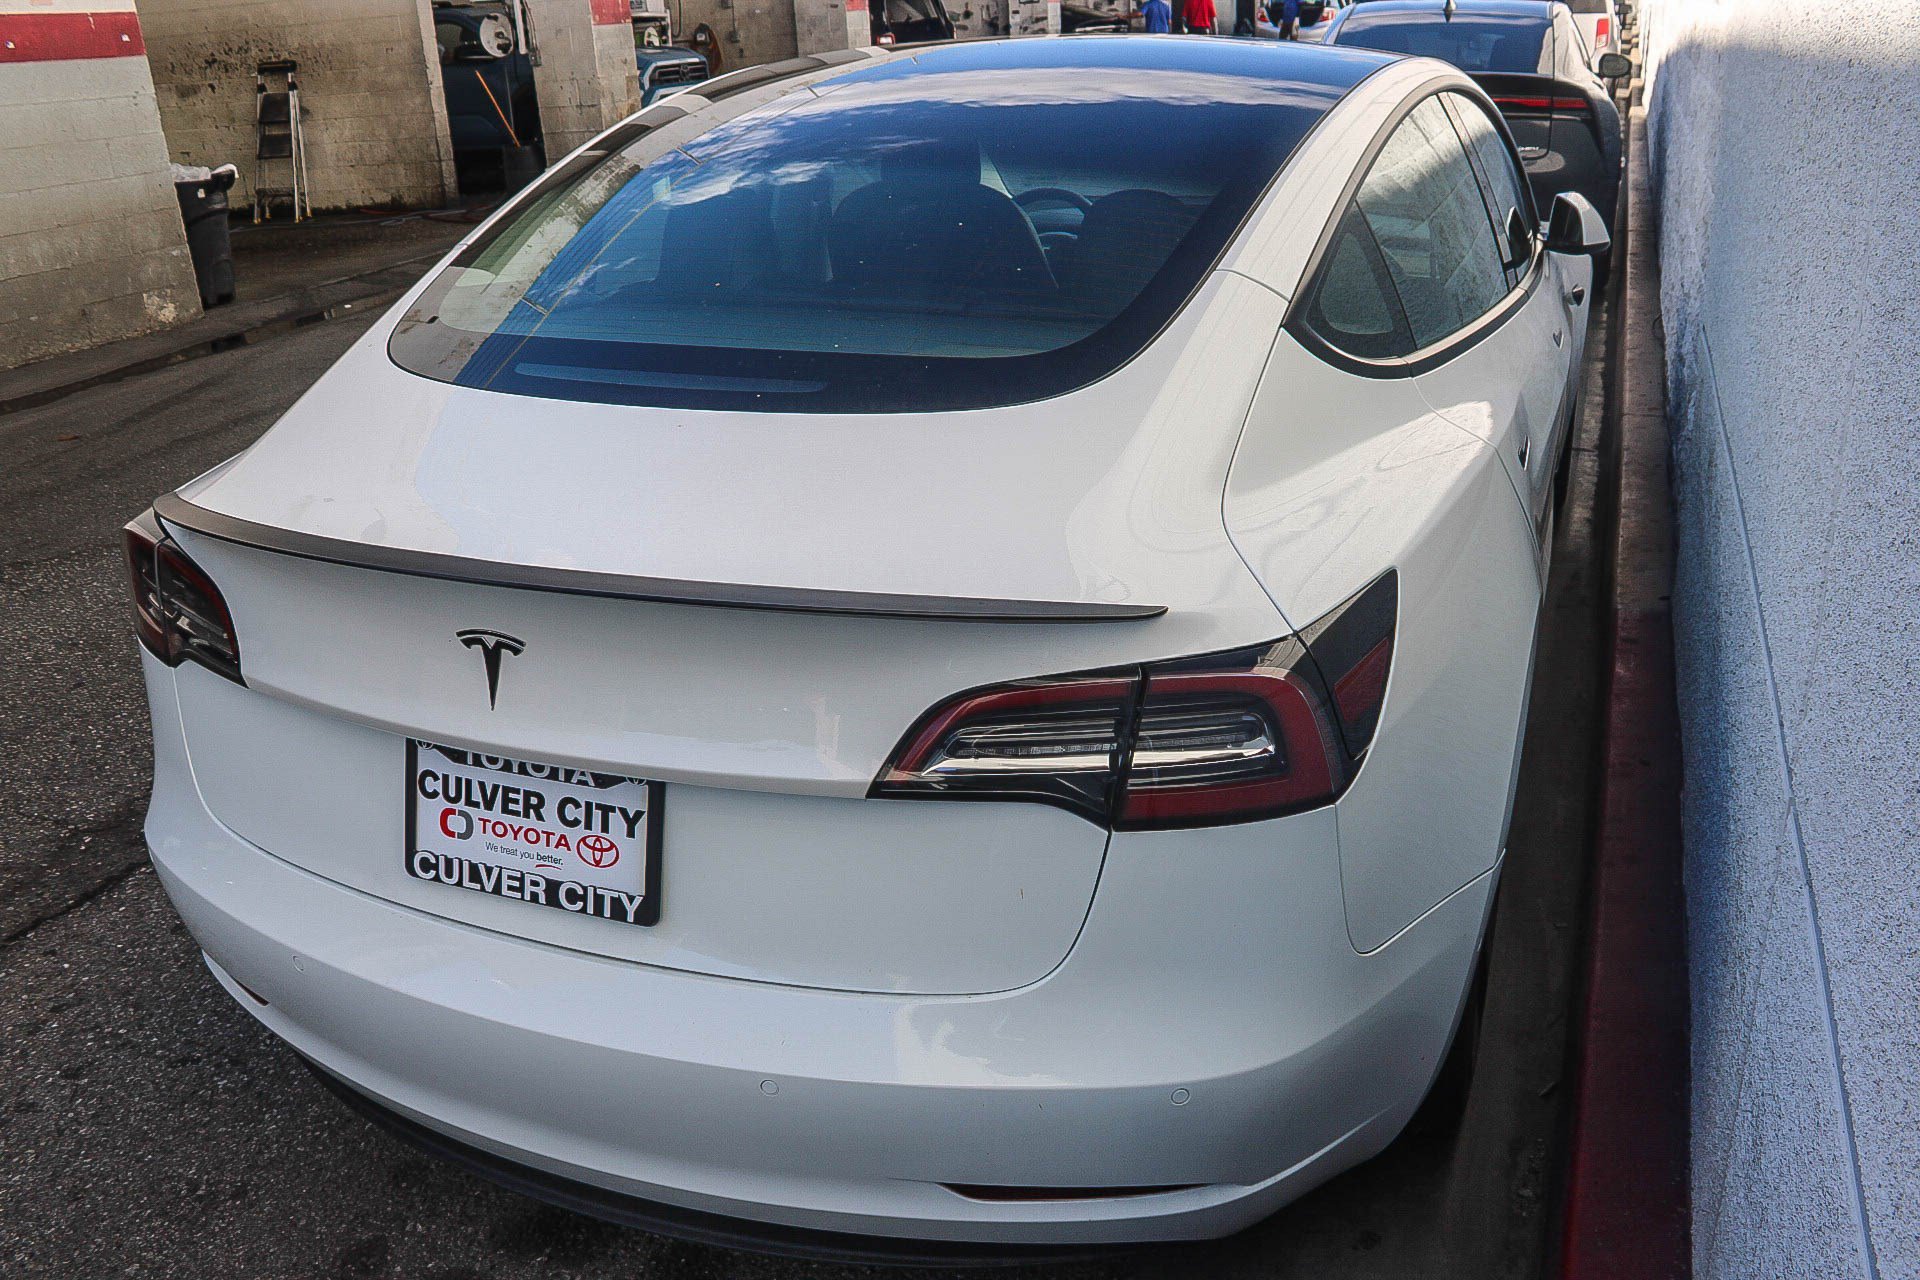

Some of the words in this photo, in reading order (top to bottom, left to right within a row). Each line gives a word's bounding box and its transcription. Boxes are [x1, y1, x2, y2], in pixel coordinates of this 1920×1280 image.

[418, 769, 546, 822] CULVER
[557, 797, 646, 839] CITY
[478, 817, 572, 852] TOYOTA
[485, 841, 498, 851] We
[500, 844, 518, 857] treat
[520, 850, 535, 861] you
[414, 851, 546, 904] CULVER
[559, 881, 643, 922] CITY
